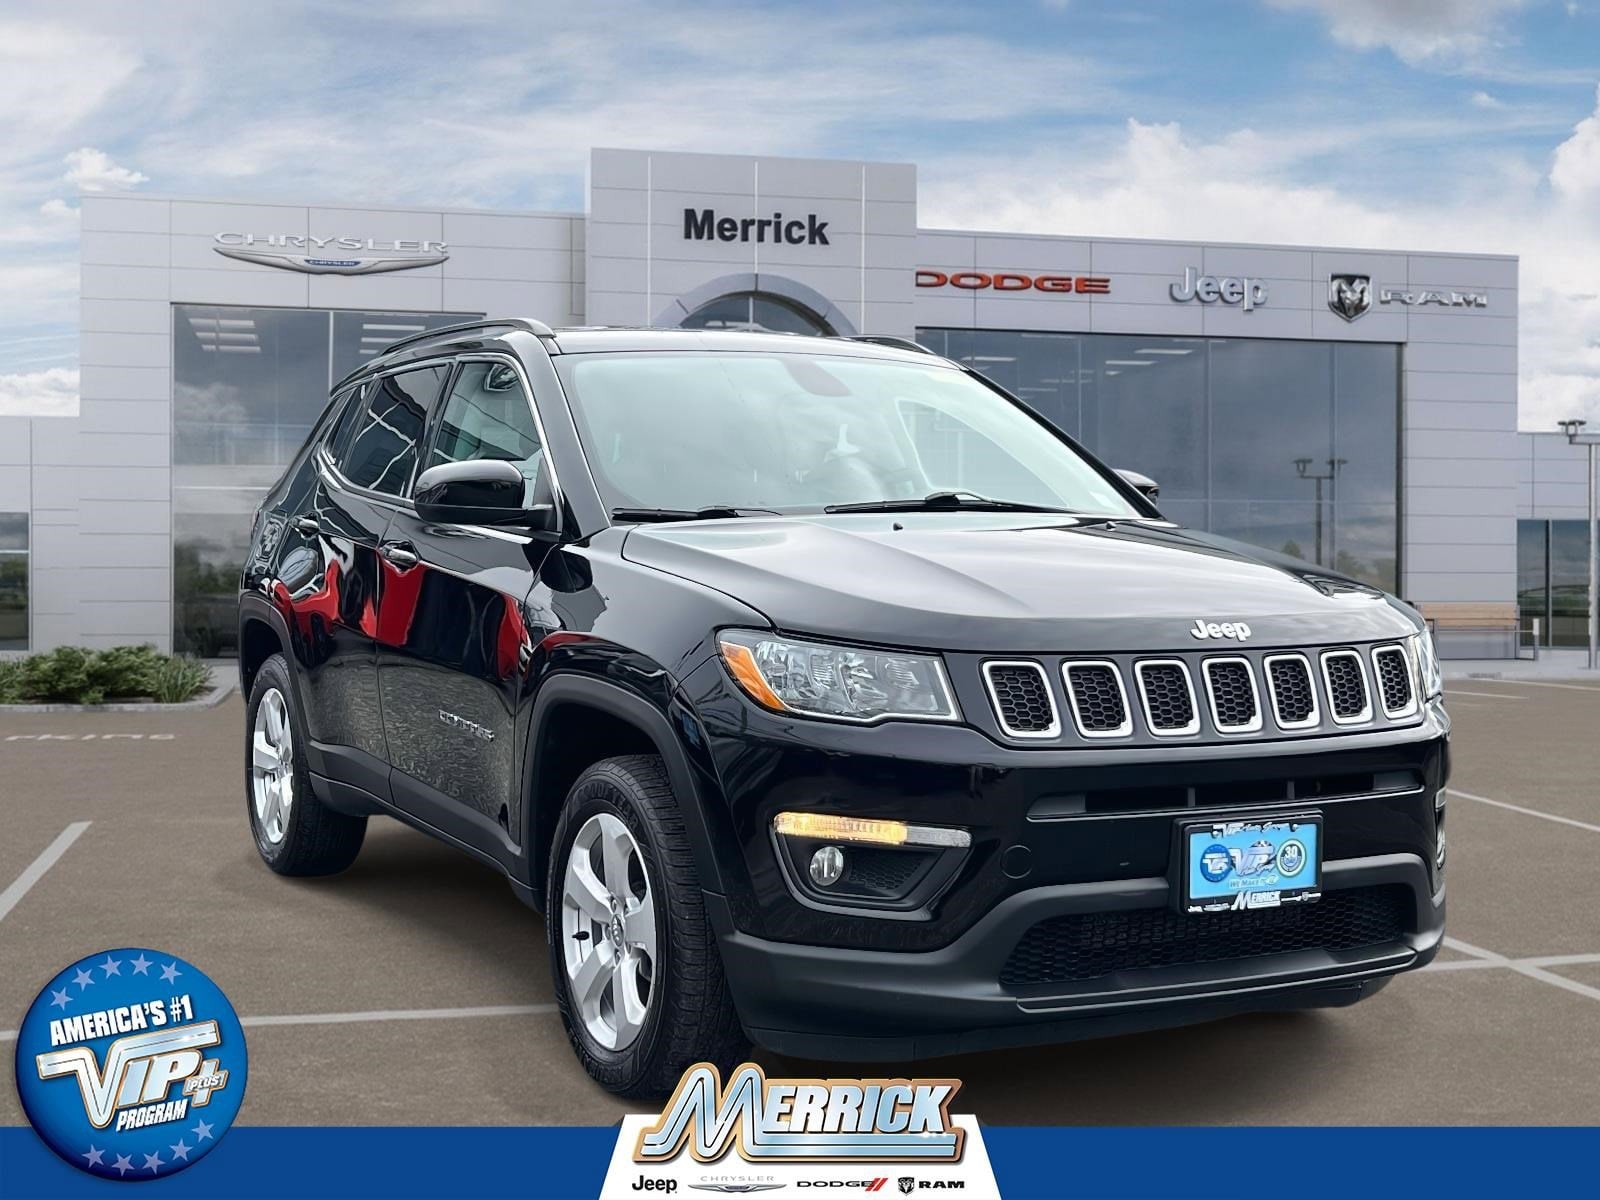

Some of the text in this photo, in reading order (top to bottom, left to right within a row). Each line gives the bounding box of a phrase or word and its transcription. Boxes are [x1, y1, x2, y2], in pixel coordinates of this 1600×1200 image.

[684, 208, 830, 245] Merrick
[214, 231, 450, 254] CHRYSLER
[915, 271, 1111, 294] DODGE
[1169, 267, 1268, 311] Jeep
[1380, 289, 1488, 308] RAM
[1190, 619, 1252, 642] Jeep
[1284, 845, 1298, 858] 30
